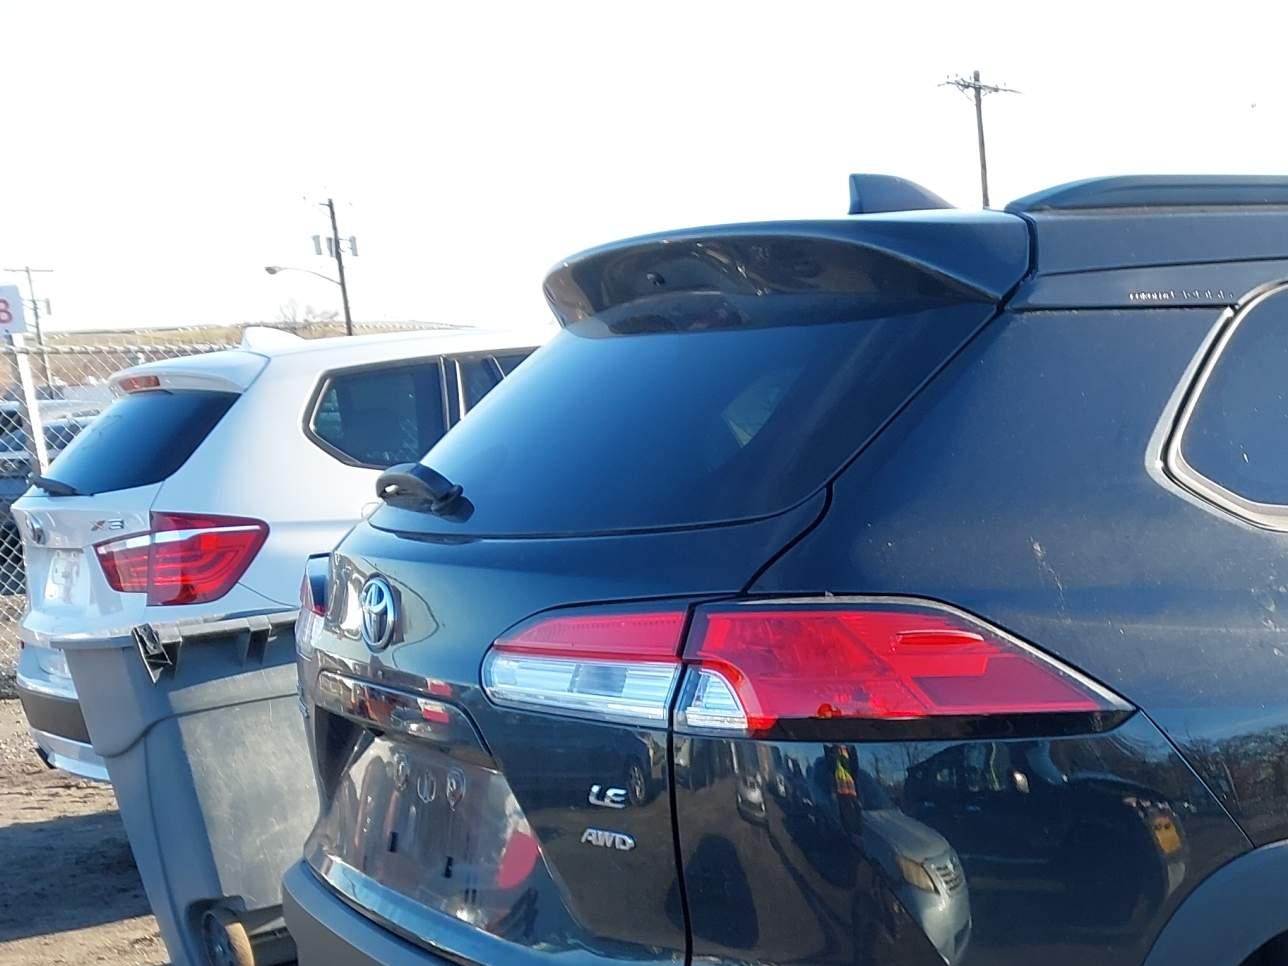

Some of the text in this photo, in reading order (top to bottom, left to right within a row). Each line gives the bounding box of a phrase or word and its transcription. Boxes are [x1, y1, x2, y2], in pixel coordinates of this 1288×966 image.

[91, 519, 124, 531] X3
[588, 784, 627, 809] LE
[580, 828, 636, 851] AWD
